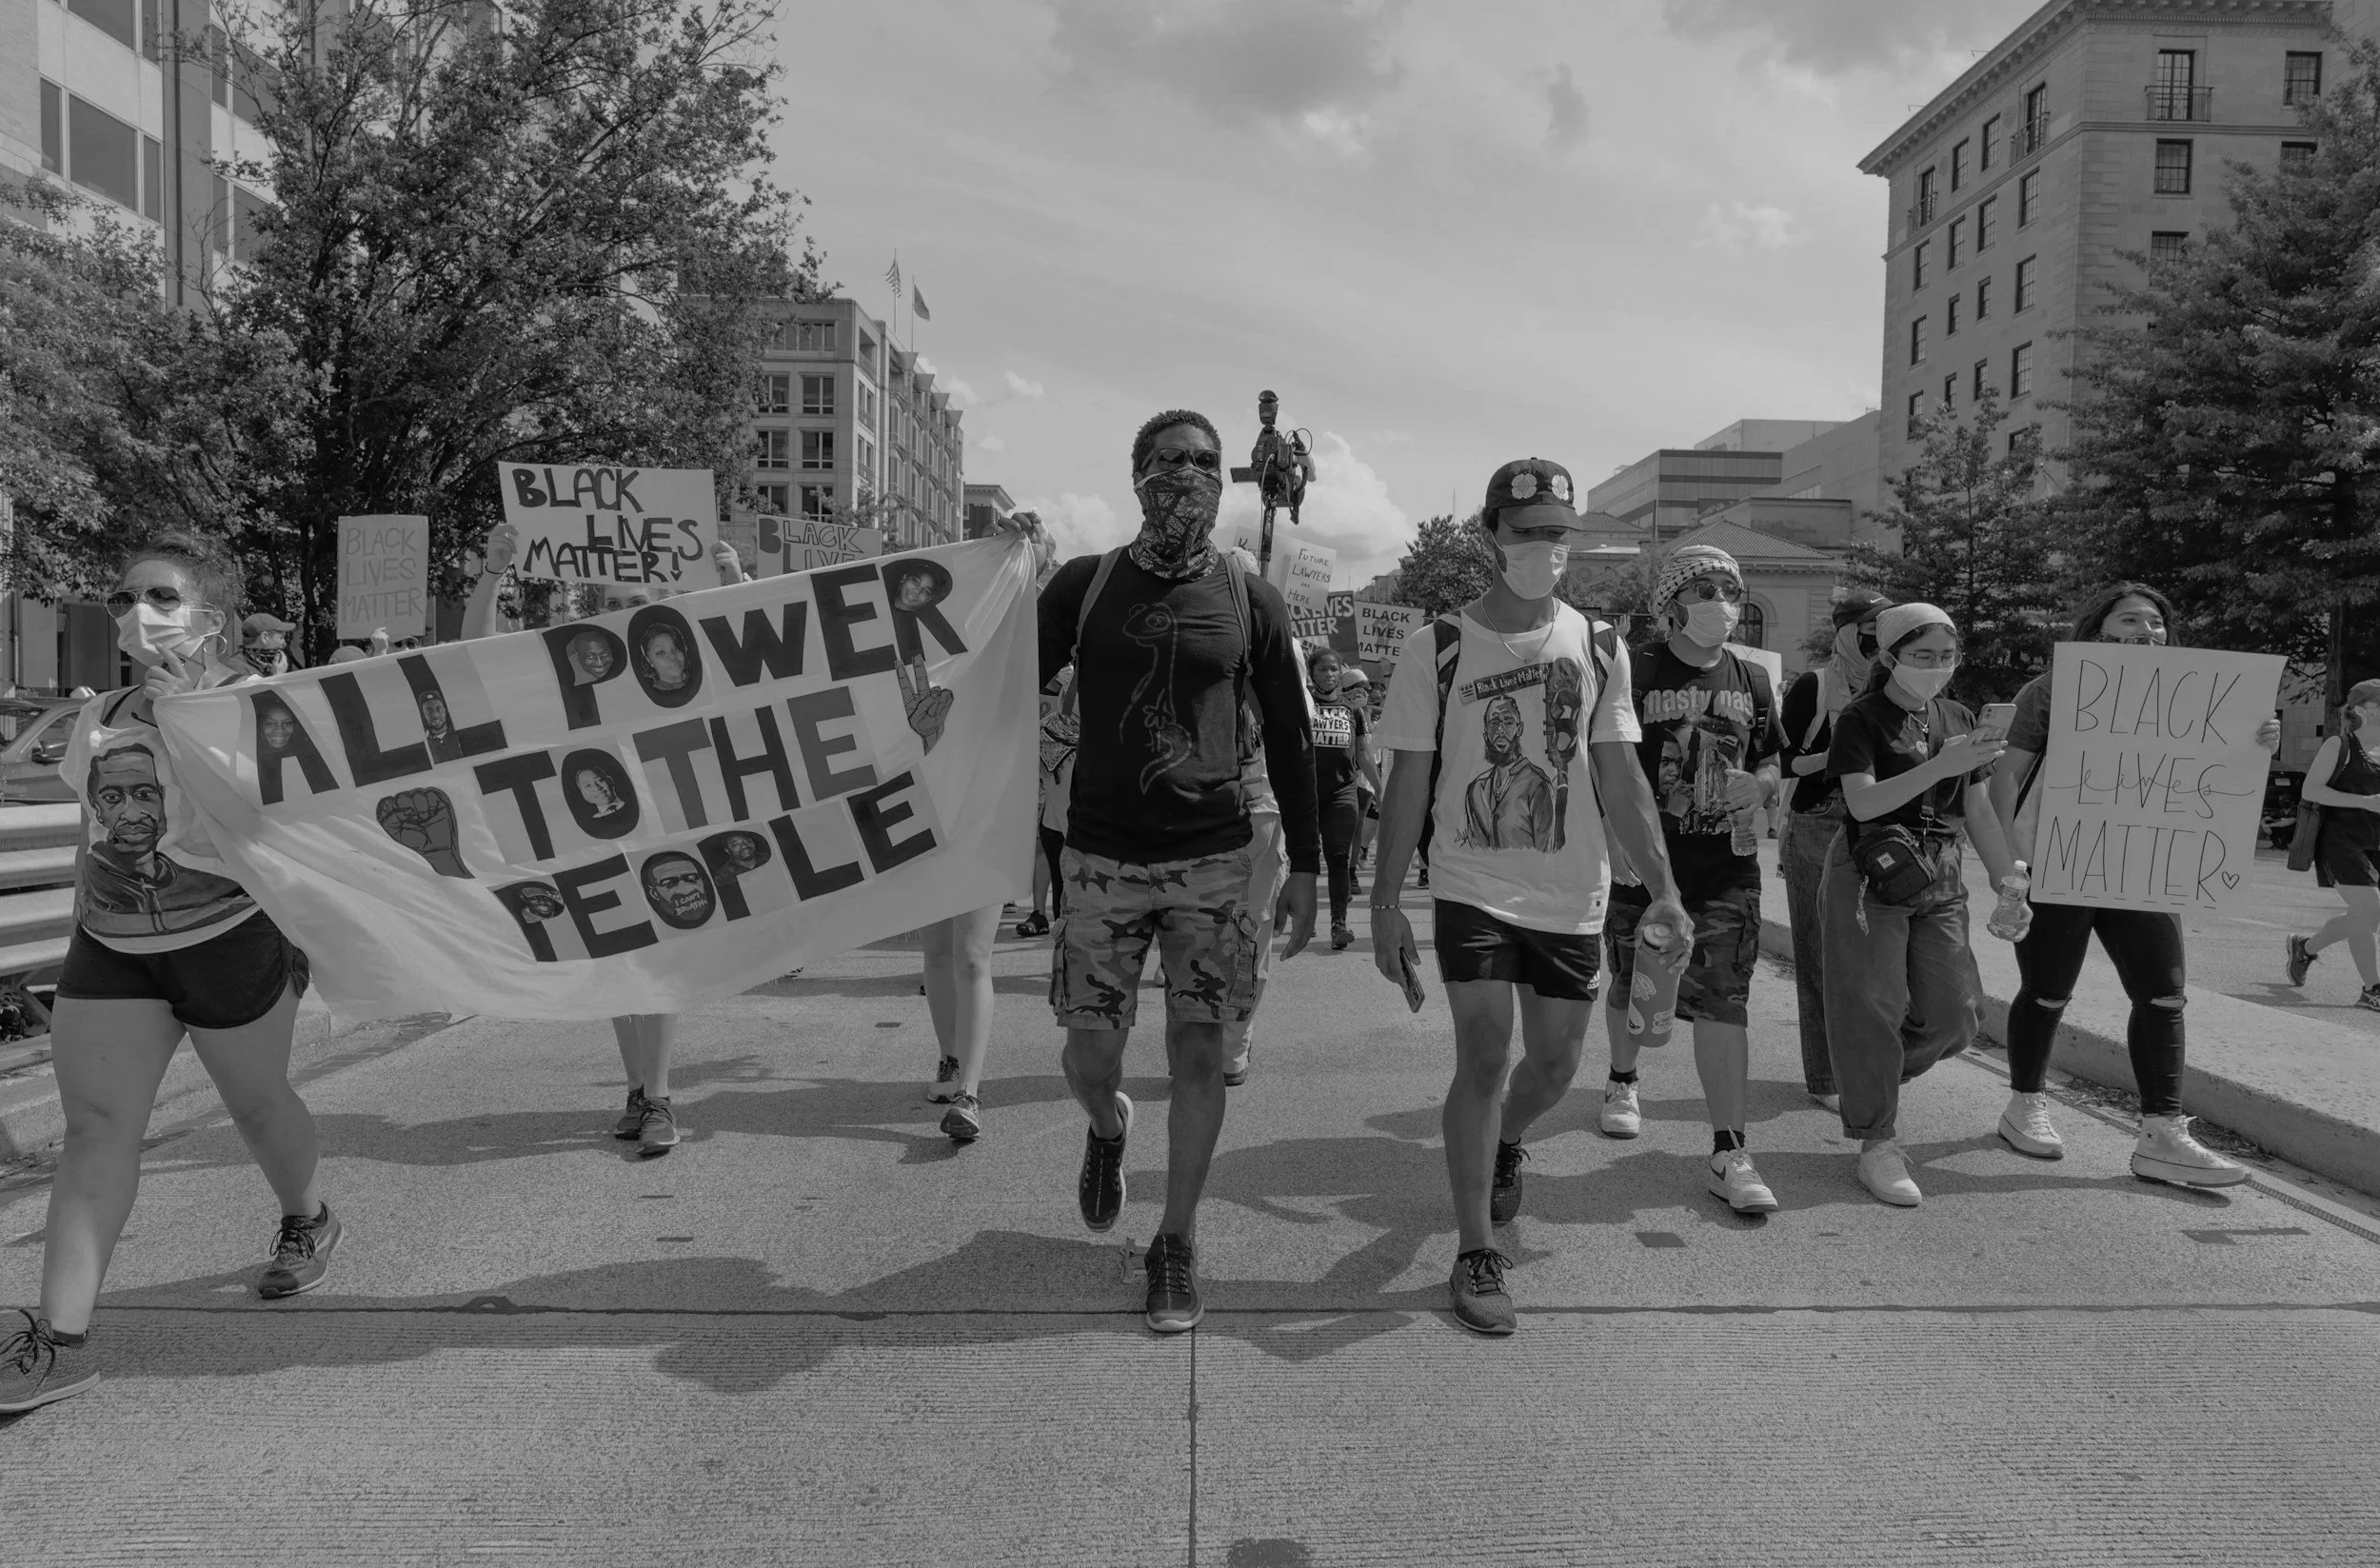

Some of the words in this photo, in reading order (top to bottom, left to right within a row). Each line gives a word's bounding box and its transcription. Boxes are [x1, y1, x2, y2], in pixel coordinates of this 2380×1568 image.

[512, 467, 645, 513] BLACK
[346, 527, 417, 556] BLACK
[586, 515, 704, 561] LIVES
[759, 518, 864, 554] BLACK
[346, 557, 417, 586] LIVES
[523, 536, 684, 584] MATTER!
[783, 543, 859, 574] LIV
[1298, 547, 1329, 566] FUTURE
[1292, 564, 1331, 584] LAWYERS
[342, 587, 425, 624] MATTER
[1287, 587, 1311, 605] HERE
[1290, 617, 1339, 637] ATTER
[1361, 607, 1411, 624] BLACK
[1362, 625, 1405, 640] LIVES
[1359, 642, 1401, 657] ATTE
[249, 654, 508, 805] ALL
[541, 558, 969, 731] POWER
[1477, 678, 1497, 694] Black
[1499, 675, 1517, 688] Lives
[1517, 667, 1543, 683] Matter
[1316, 705, 1349, 721] LACK
[1643, 685, 1713, 722] nasty
[2073, 658, 2242, 745] BLACK
[1313, 719, 1349, 730] AWYERS
[2077, 750, 2228, 820] LIVES
[491, 770, 938, 963] PEOPLE
[2041, 815, 2227, 903] MATTER
